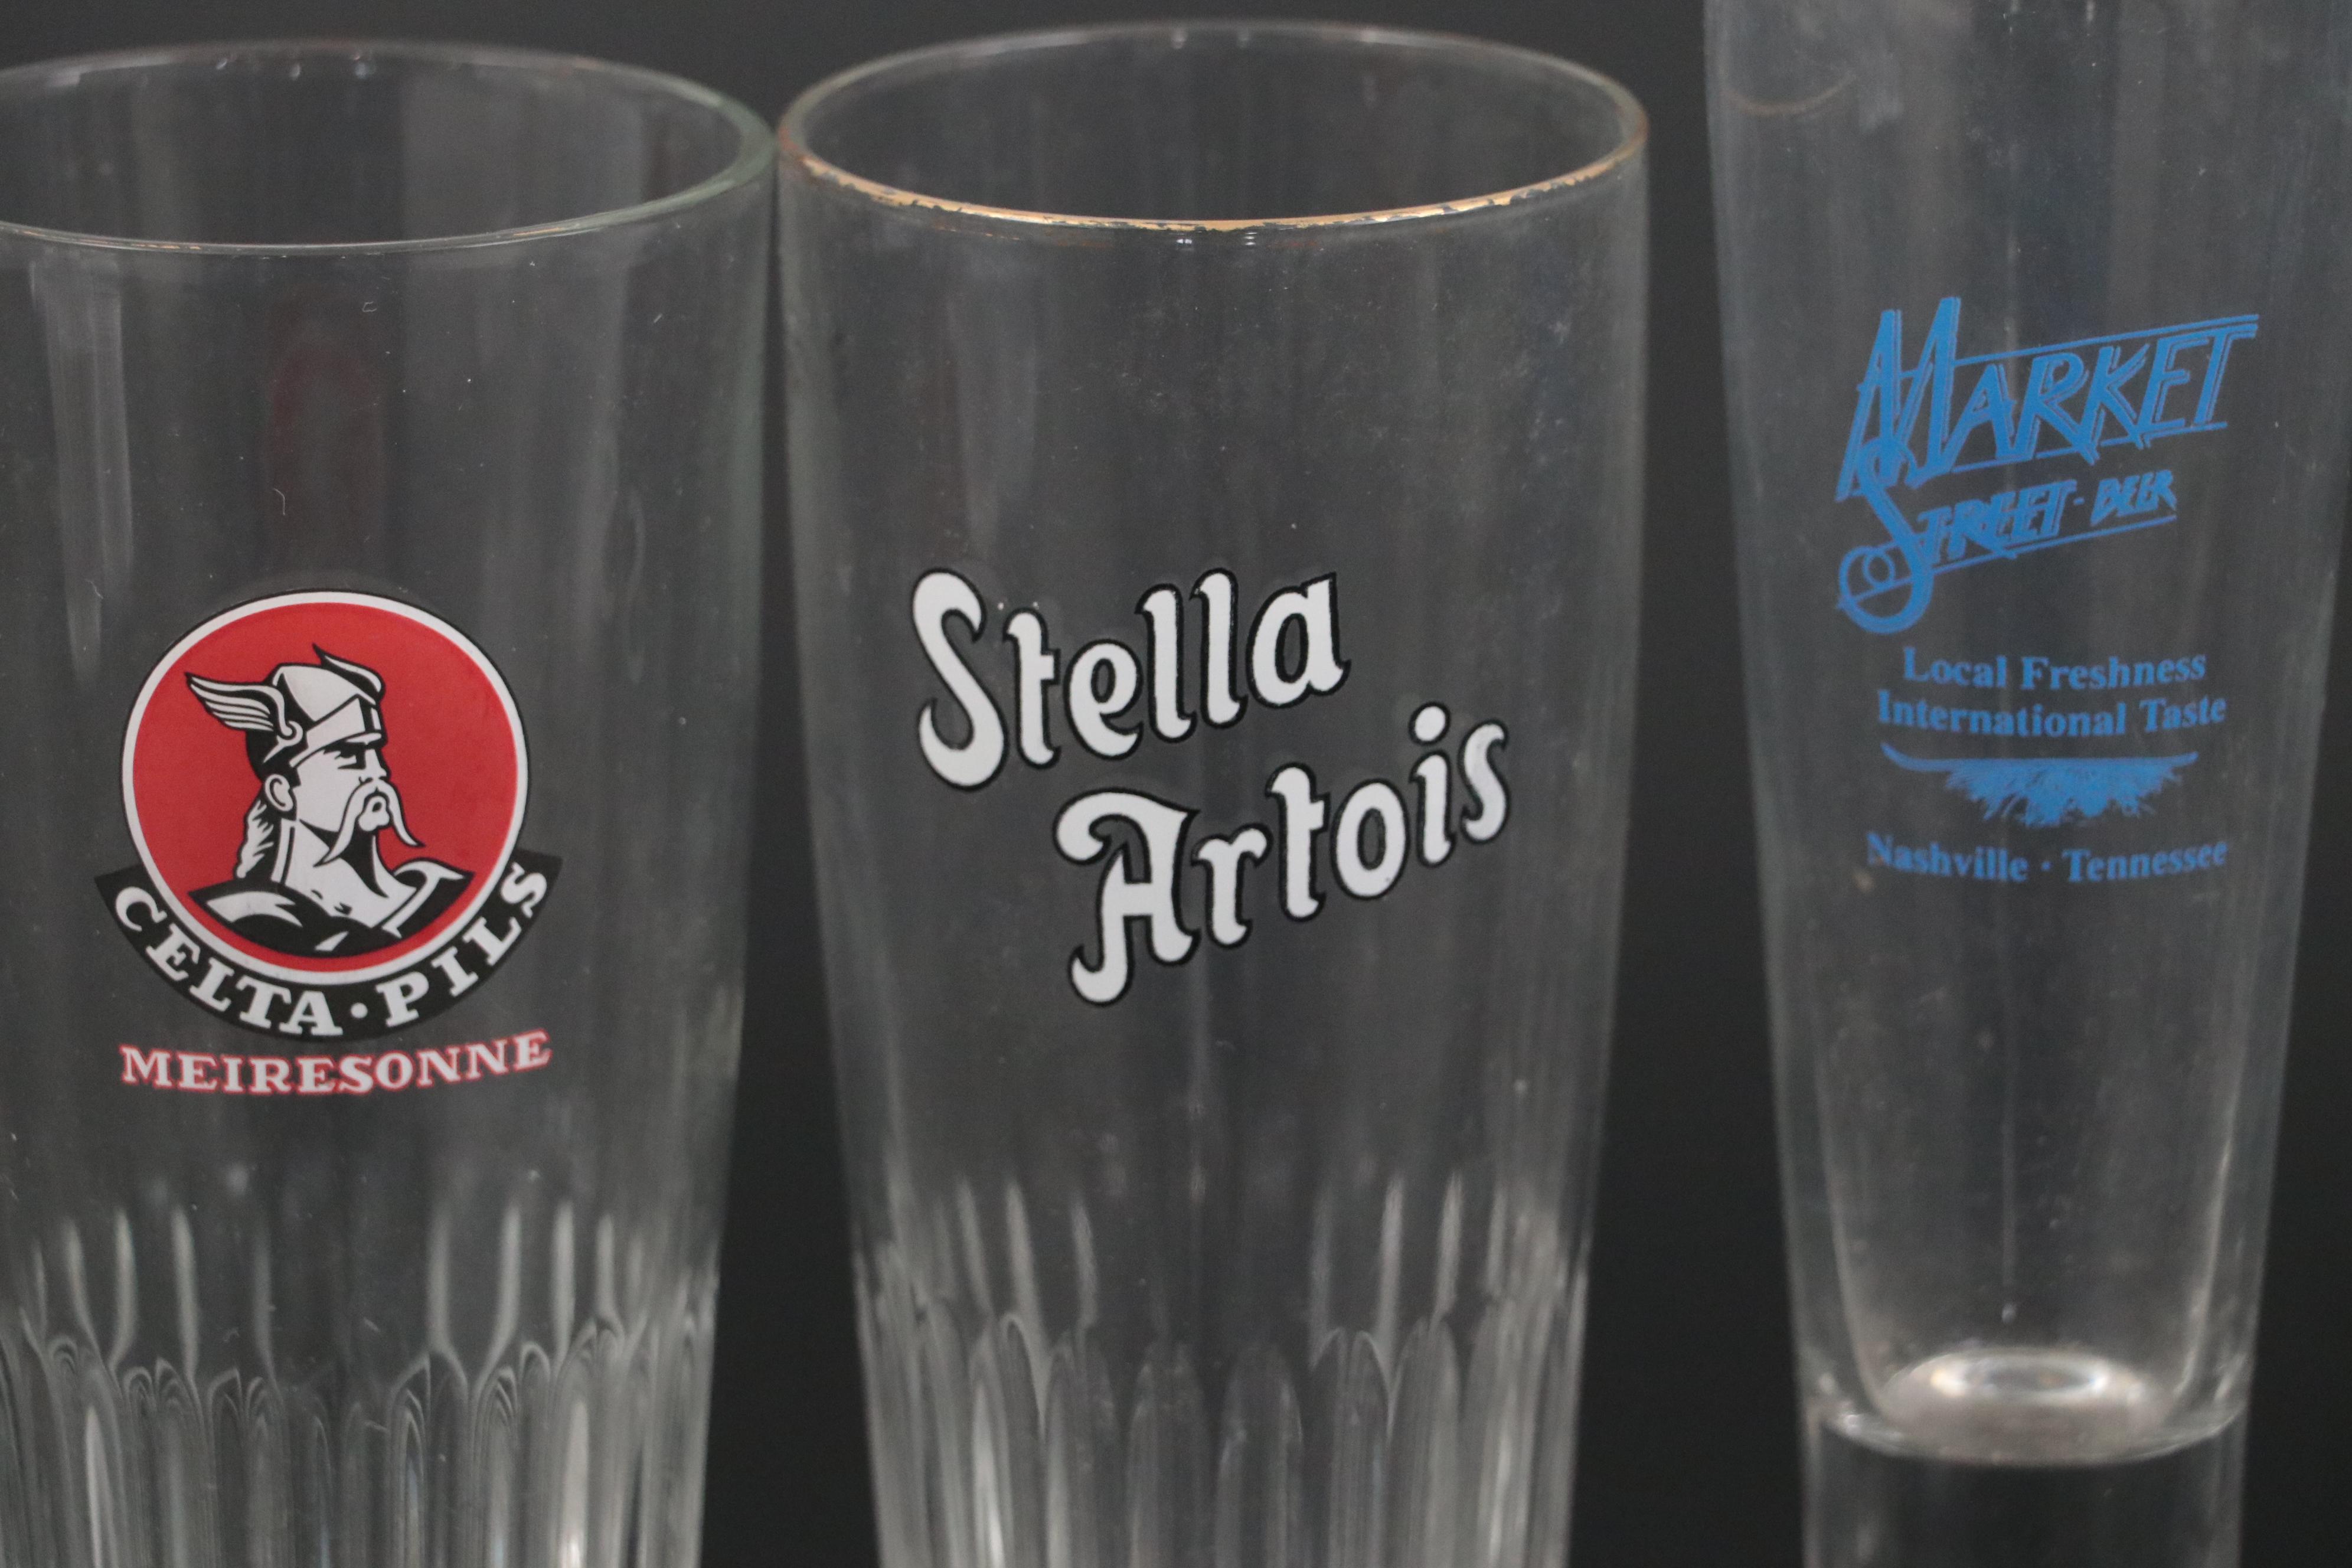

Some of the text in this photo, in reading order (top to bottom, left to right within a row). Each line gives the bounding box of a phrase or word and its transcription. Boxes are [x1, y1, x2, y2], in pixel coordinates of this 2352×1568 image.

[1834, 296, 2260, 502] MARKET
[912, 567, 1351, 791] Stella
[1877, 688, 2227, 738] International Taste
[1903, 646, 2207, 691] Local Freshness
[1054, 702, 1510, 1006] Artois
[1866, 831, 2229, 883] Nashville Tennessee
[115, 861, 547, 1037] CELTA PILS
[119, 1029, 553, 1096] MEIRESONNE
